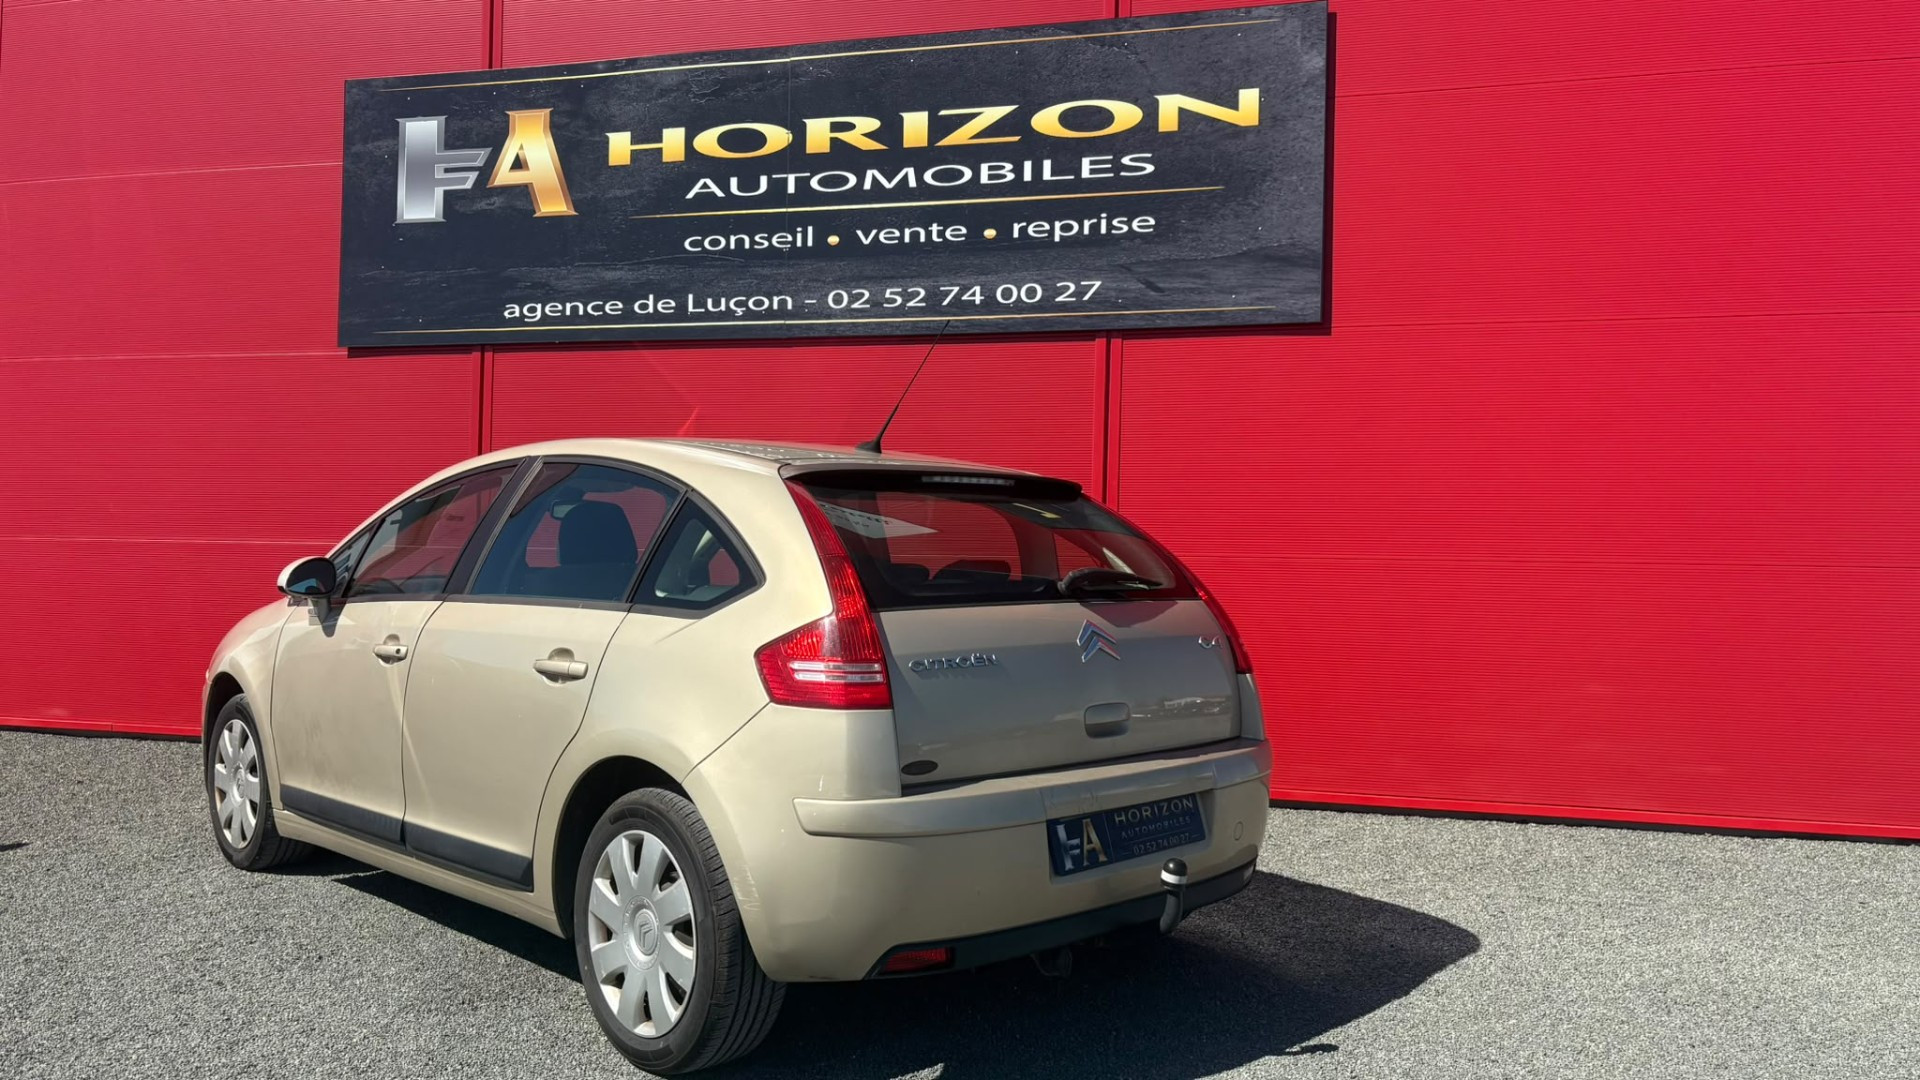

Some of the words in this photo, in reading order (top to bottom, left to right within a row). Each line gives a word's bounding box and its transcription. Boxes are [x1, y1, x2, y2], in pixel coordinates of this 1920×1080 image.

[605, 87, 1260, 166] HORIZON
[685, 153, 1156, 199] AUTOMOBILES
[684, 225, 814, 252] conseil
[855, 222, 968, 245] vente
[1012, 213, 1156, 242] reprise
[503, 300, 624, 323] agence
[633, 294, 677, 315] de
[688, 292, 793, 316] Luçon
[827, 288, 871, 309] 02
[883, 287, 926, 308] 52
[939, 285, 985, 306] 74
[995, 282, 1043, 304] 00
[1054, 280, 1102, 302] 27
[908, 652, 998, 672] CITROËN
[1114, 796, 1194, 824] HORIZON
[1120, 815, 1192, 839] AUTOMOBILES
[1133, 844, 1145, 856] 02
[1146, 841, 1157, 852] 52
[1157, 839, 1169, 849] 74
